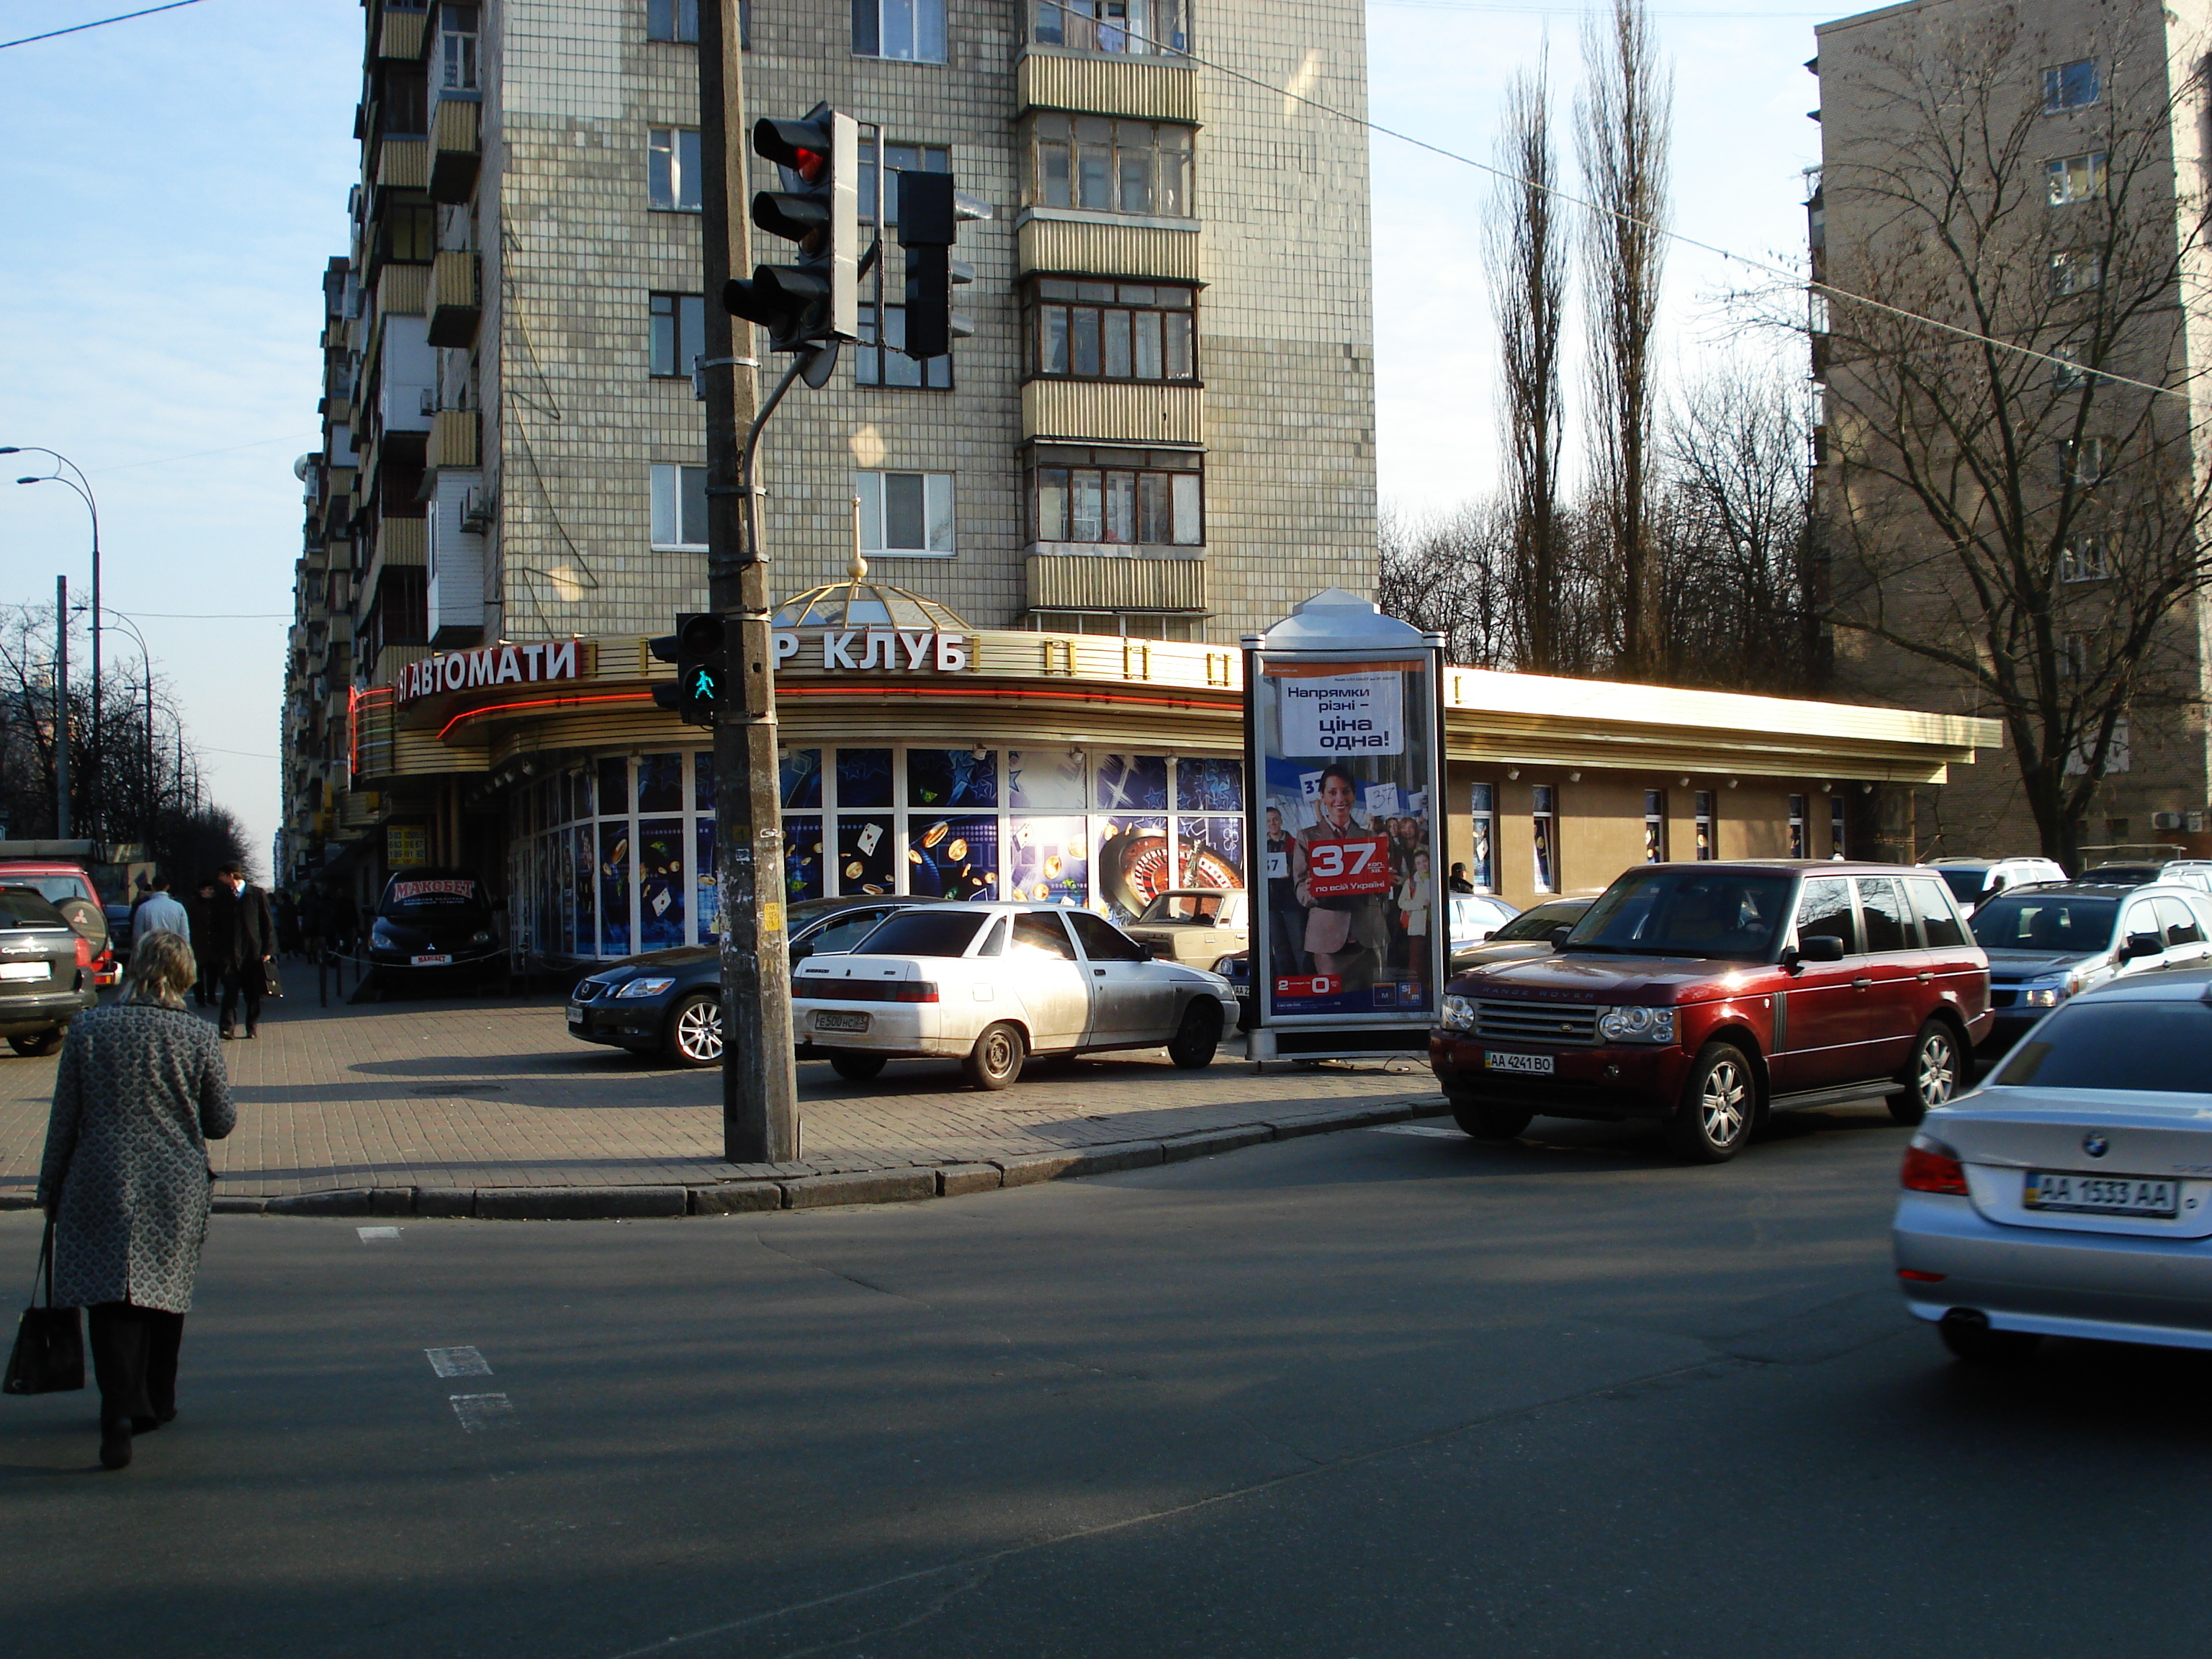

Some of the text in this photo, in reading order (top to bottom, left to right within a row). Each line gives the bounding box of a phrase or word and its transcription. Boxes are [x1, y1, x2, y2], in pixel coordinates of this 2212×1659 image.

[823, 631, 966, 671] КЛУБ
[410, 642, 575, 698] АВТОМАТИ
[1287, 687, 1370, 700] Напрямки
[1318, 700, 1355, 713] різні
[1319, 716, 1372, 734] ціна
[1319, 731, 1390, 751] одна!
[1372, 787, 1395, 809] 37
[1312, 842, 1377, 877] 37
[393, 880, 475, 903] МАКСБЕТ
[1330, 883, 1349, 892] всій
[1350, 880, 1385, 890] Україні
[1278, 980, 1288, 991] 2
[1483, 987, 1594, 999] RANGE ROVER
